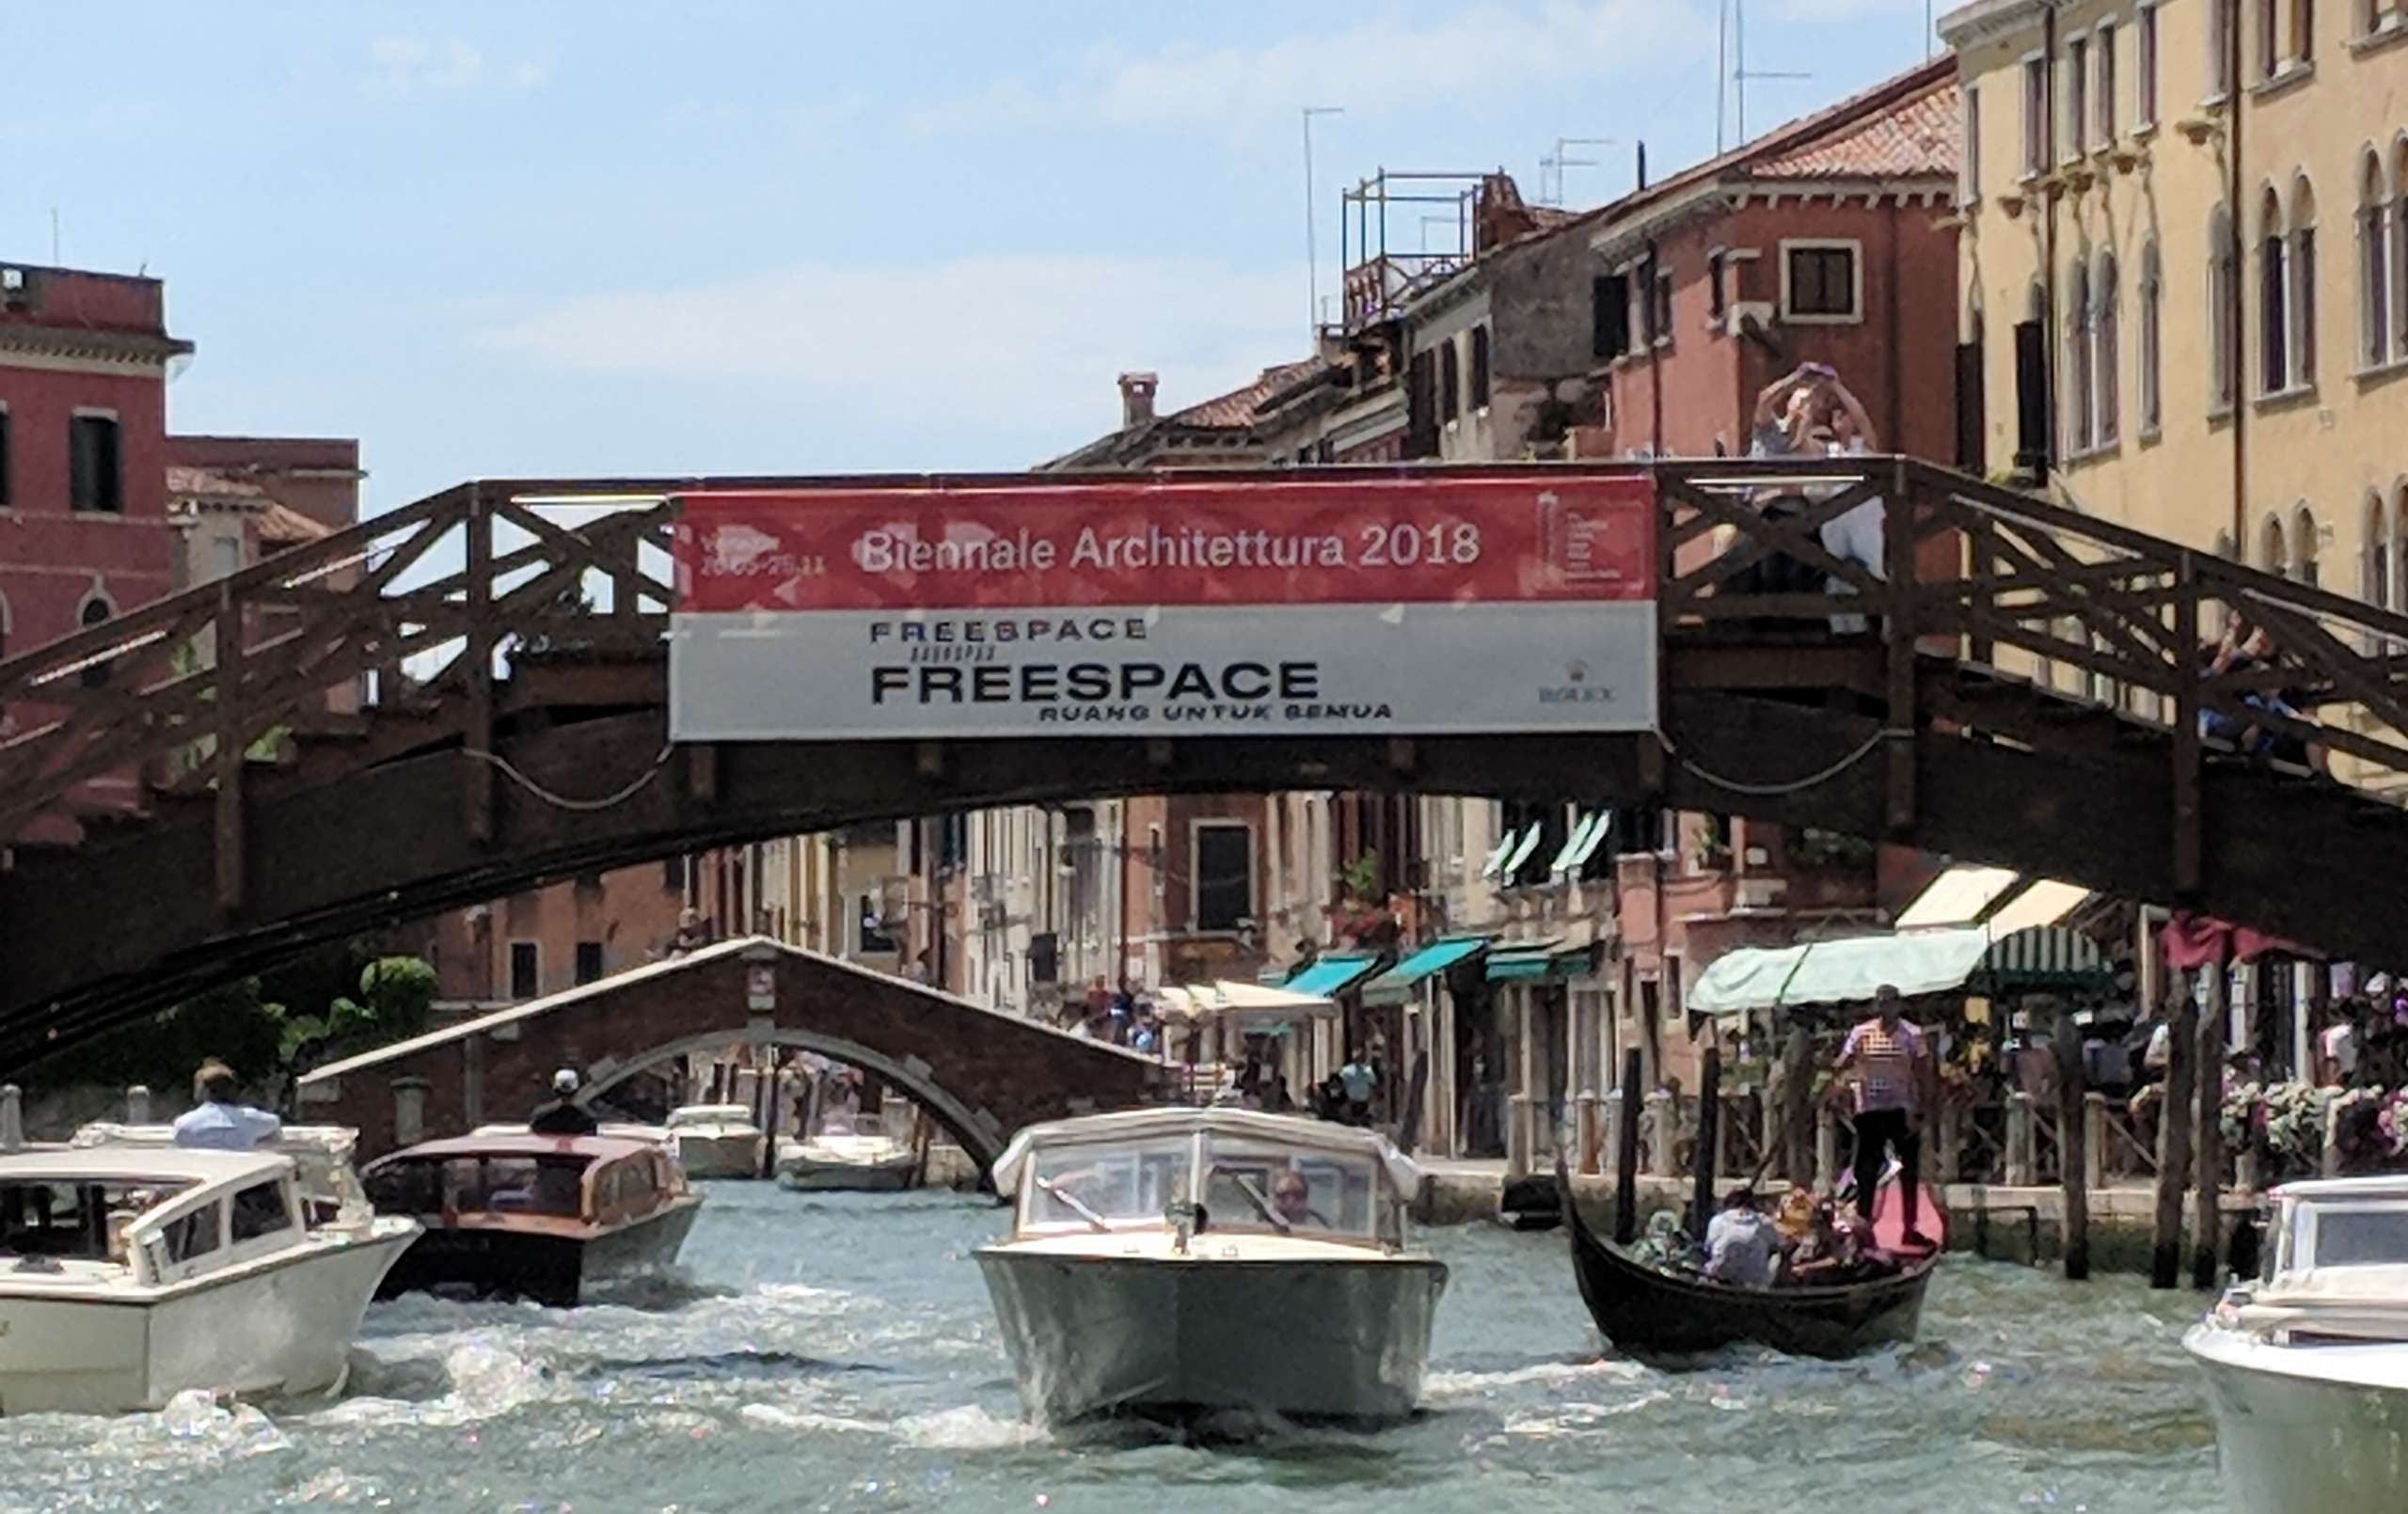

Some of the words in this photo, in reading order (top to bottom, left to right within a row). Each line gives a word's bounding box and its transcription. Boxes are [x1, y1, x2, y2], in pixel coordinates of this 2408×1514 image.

[862, 526, 1056, 572] Biennale
[1069, 525, 1345, 568] Architettura
[1358, 522, 1481, 566] 2018
[870, 618, 1148, 643] FREESPACE
[872, 661, 1318, 704] FREESPACE
[1039, 704, 1150, 721] RUANG
[1163, 704, 1272, 721] UNTUK
[1285, 703, 1393, 719] SEMUA
